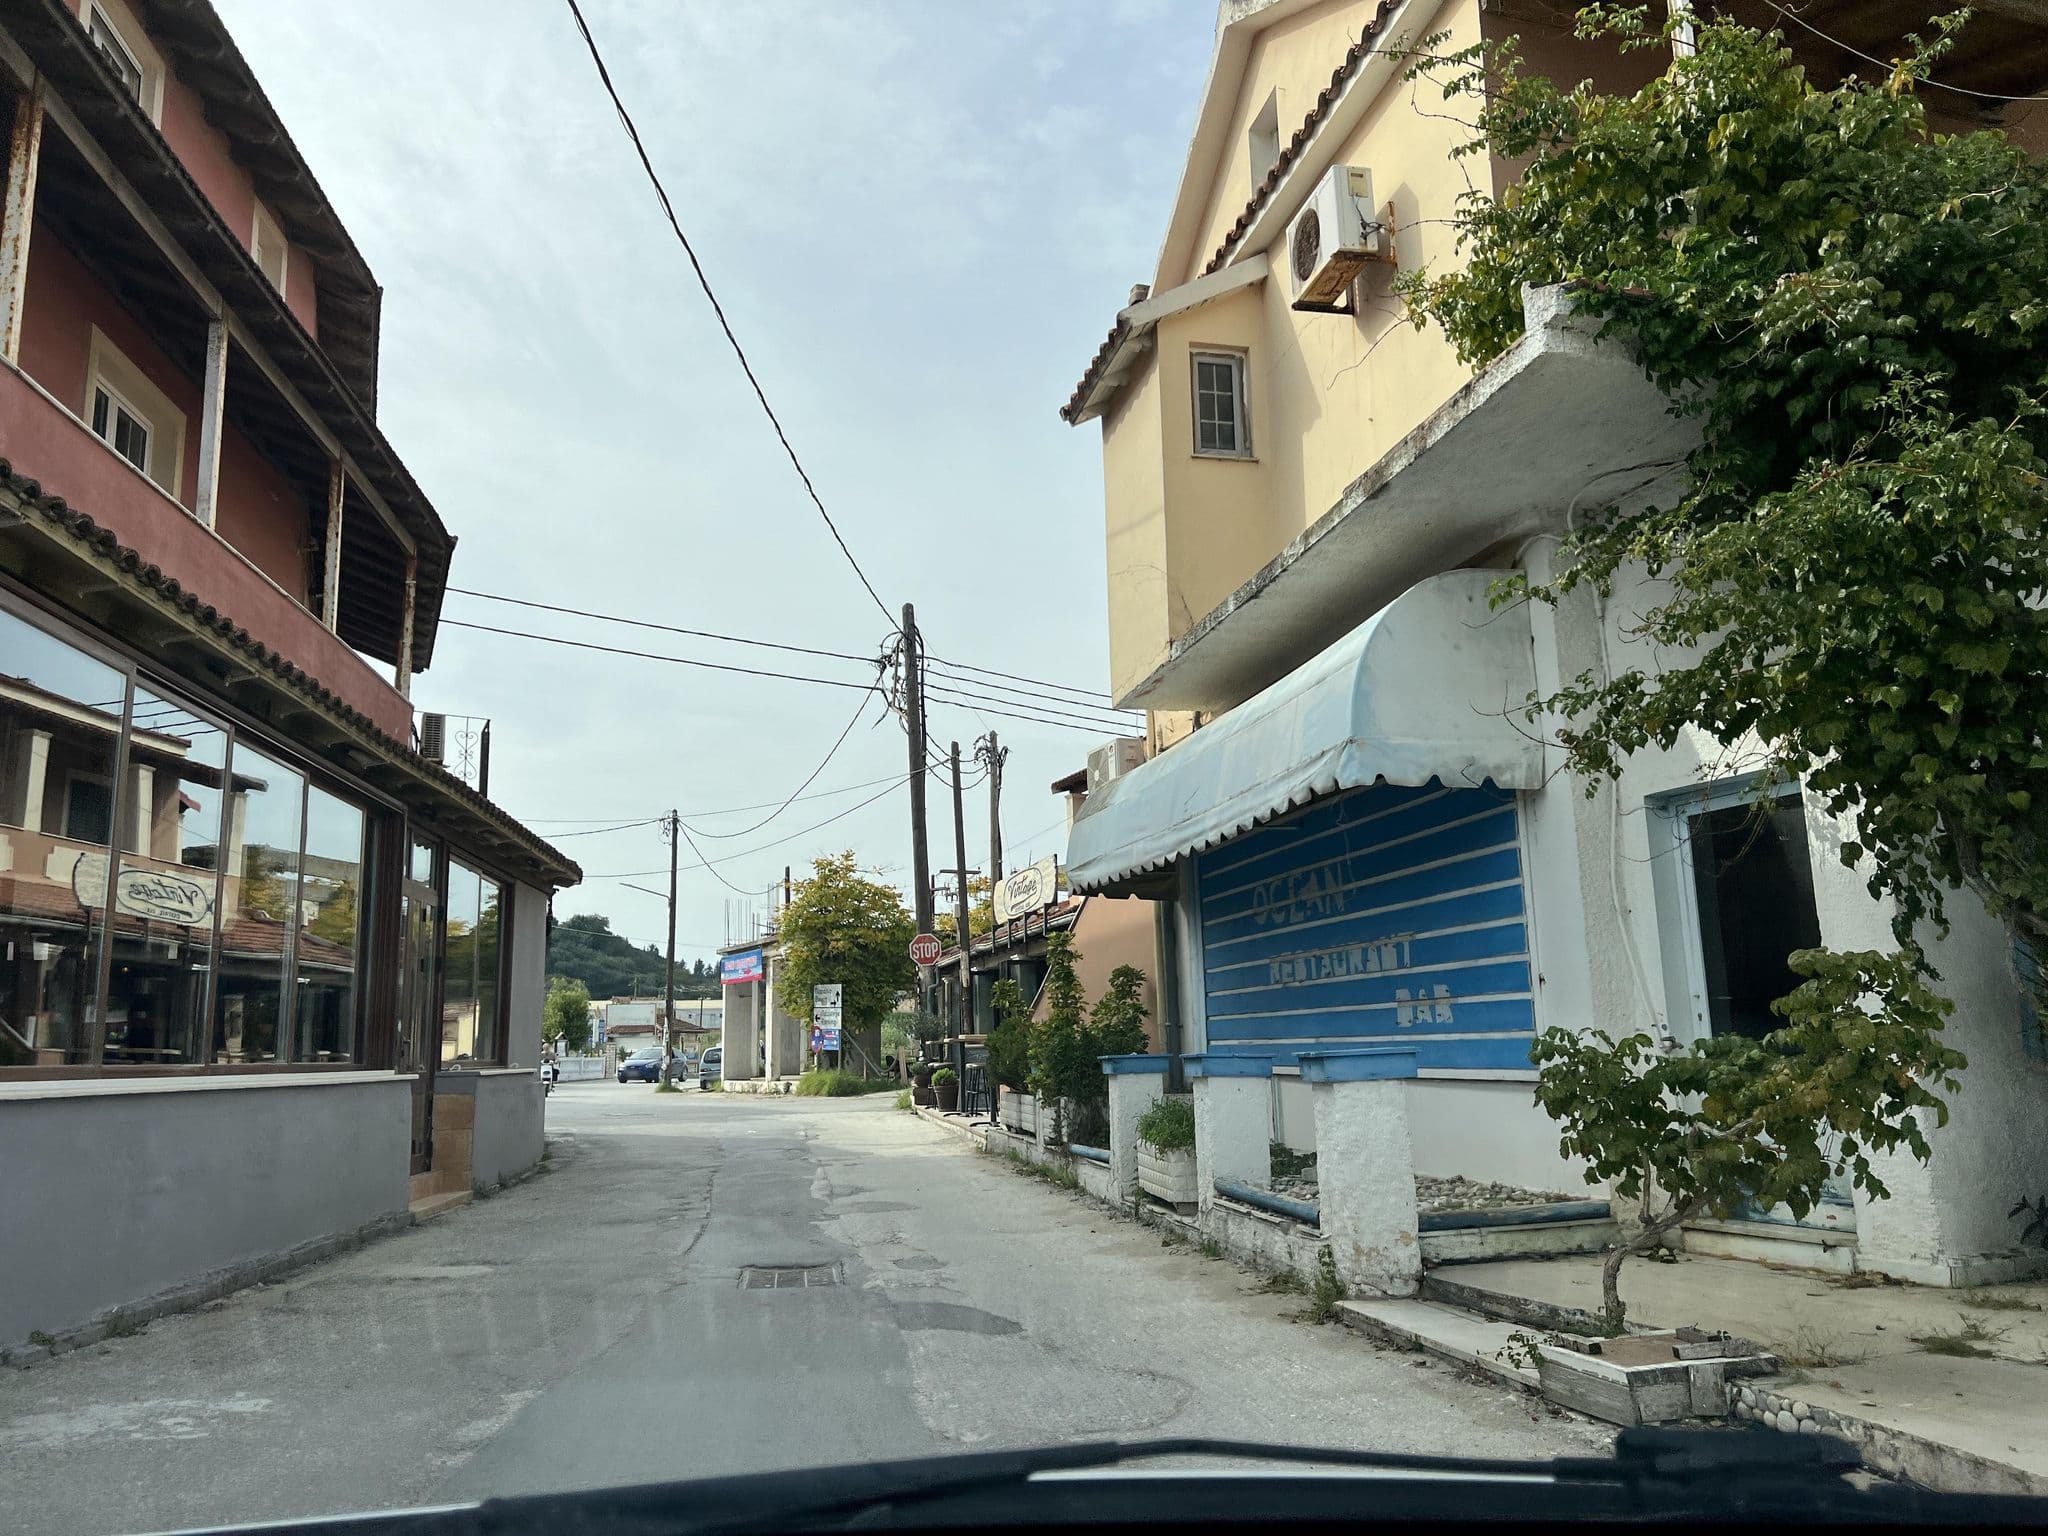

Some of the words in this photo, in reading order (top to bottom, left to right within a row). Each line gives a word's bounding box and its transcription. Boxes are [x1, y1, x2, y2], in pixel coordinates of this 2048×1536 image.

[1252, 860, 1345, 925] OCEAN
[912, 942, 938, 959] STOP
[1269, 931, 1416, 985] RESTAURANT
[1395, 984, 1454, 1028] BAR
